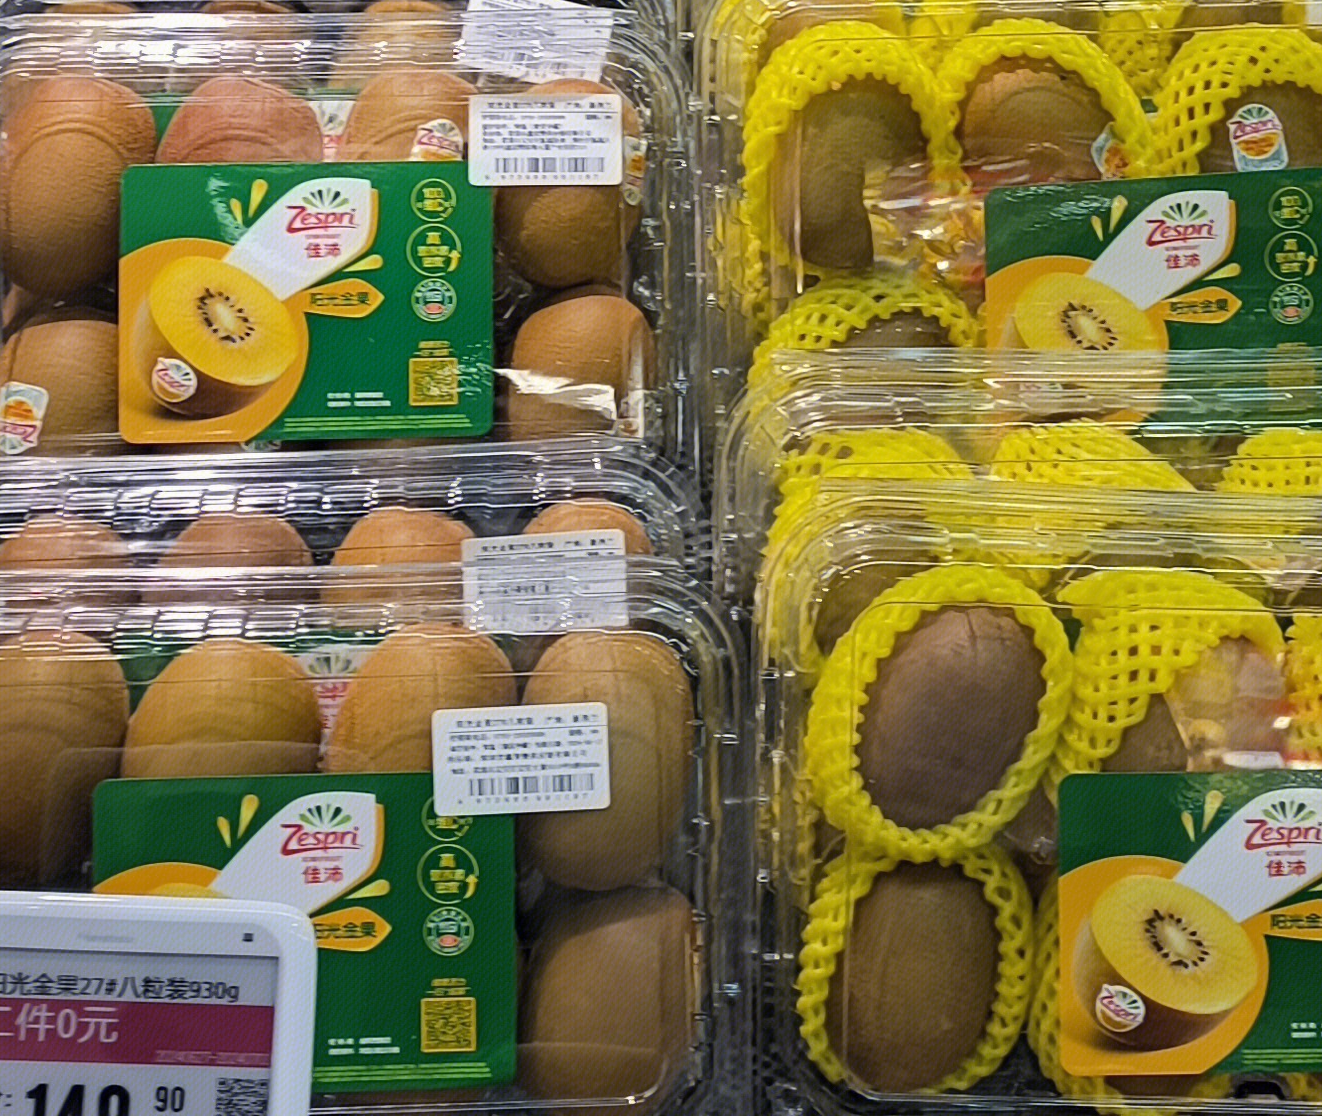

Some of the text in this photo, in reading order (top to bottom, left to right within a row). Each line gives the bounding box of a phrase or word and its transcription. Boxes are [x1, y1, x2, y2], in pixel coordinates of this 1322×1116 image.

[284, 204, 360, 233] Zespri
[1145, 217, 1218, 247] Zespri
[303, 242, 342, 259] 佳沛
[1164, 252, 1202, 270] 佳沛
[280, 823, 365, 856] Zespri
[301, 865, 344, 885] 佳沛
[1264, 859, 1307, 878] 佳沛
[154, 1086, 185, 1112] 90
